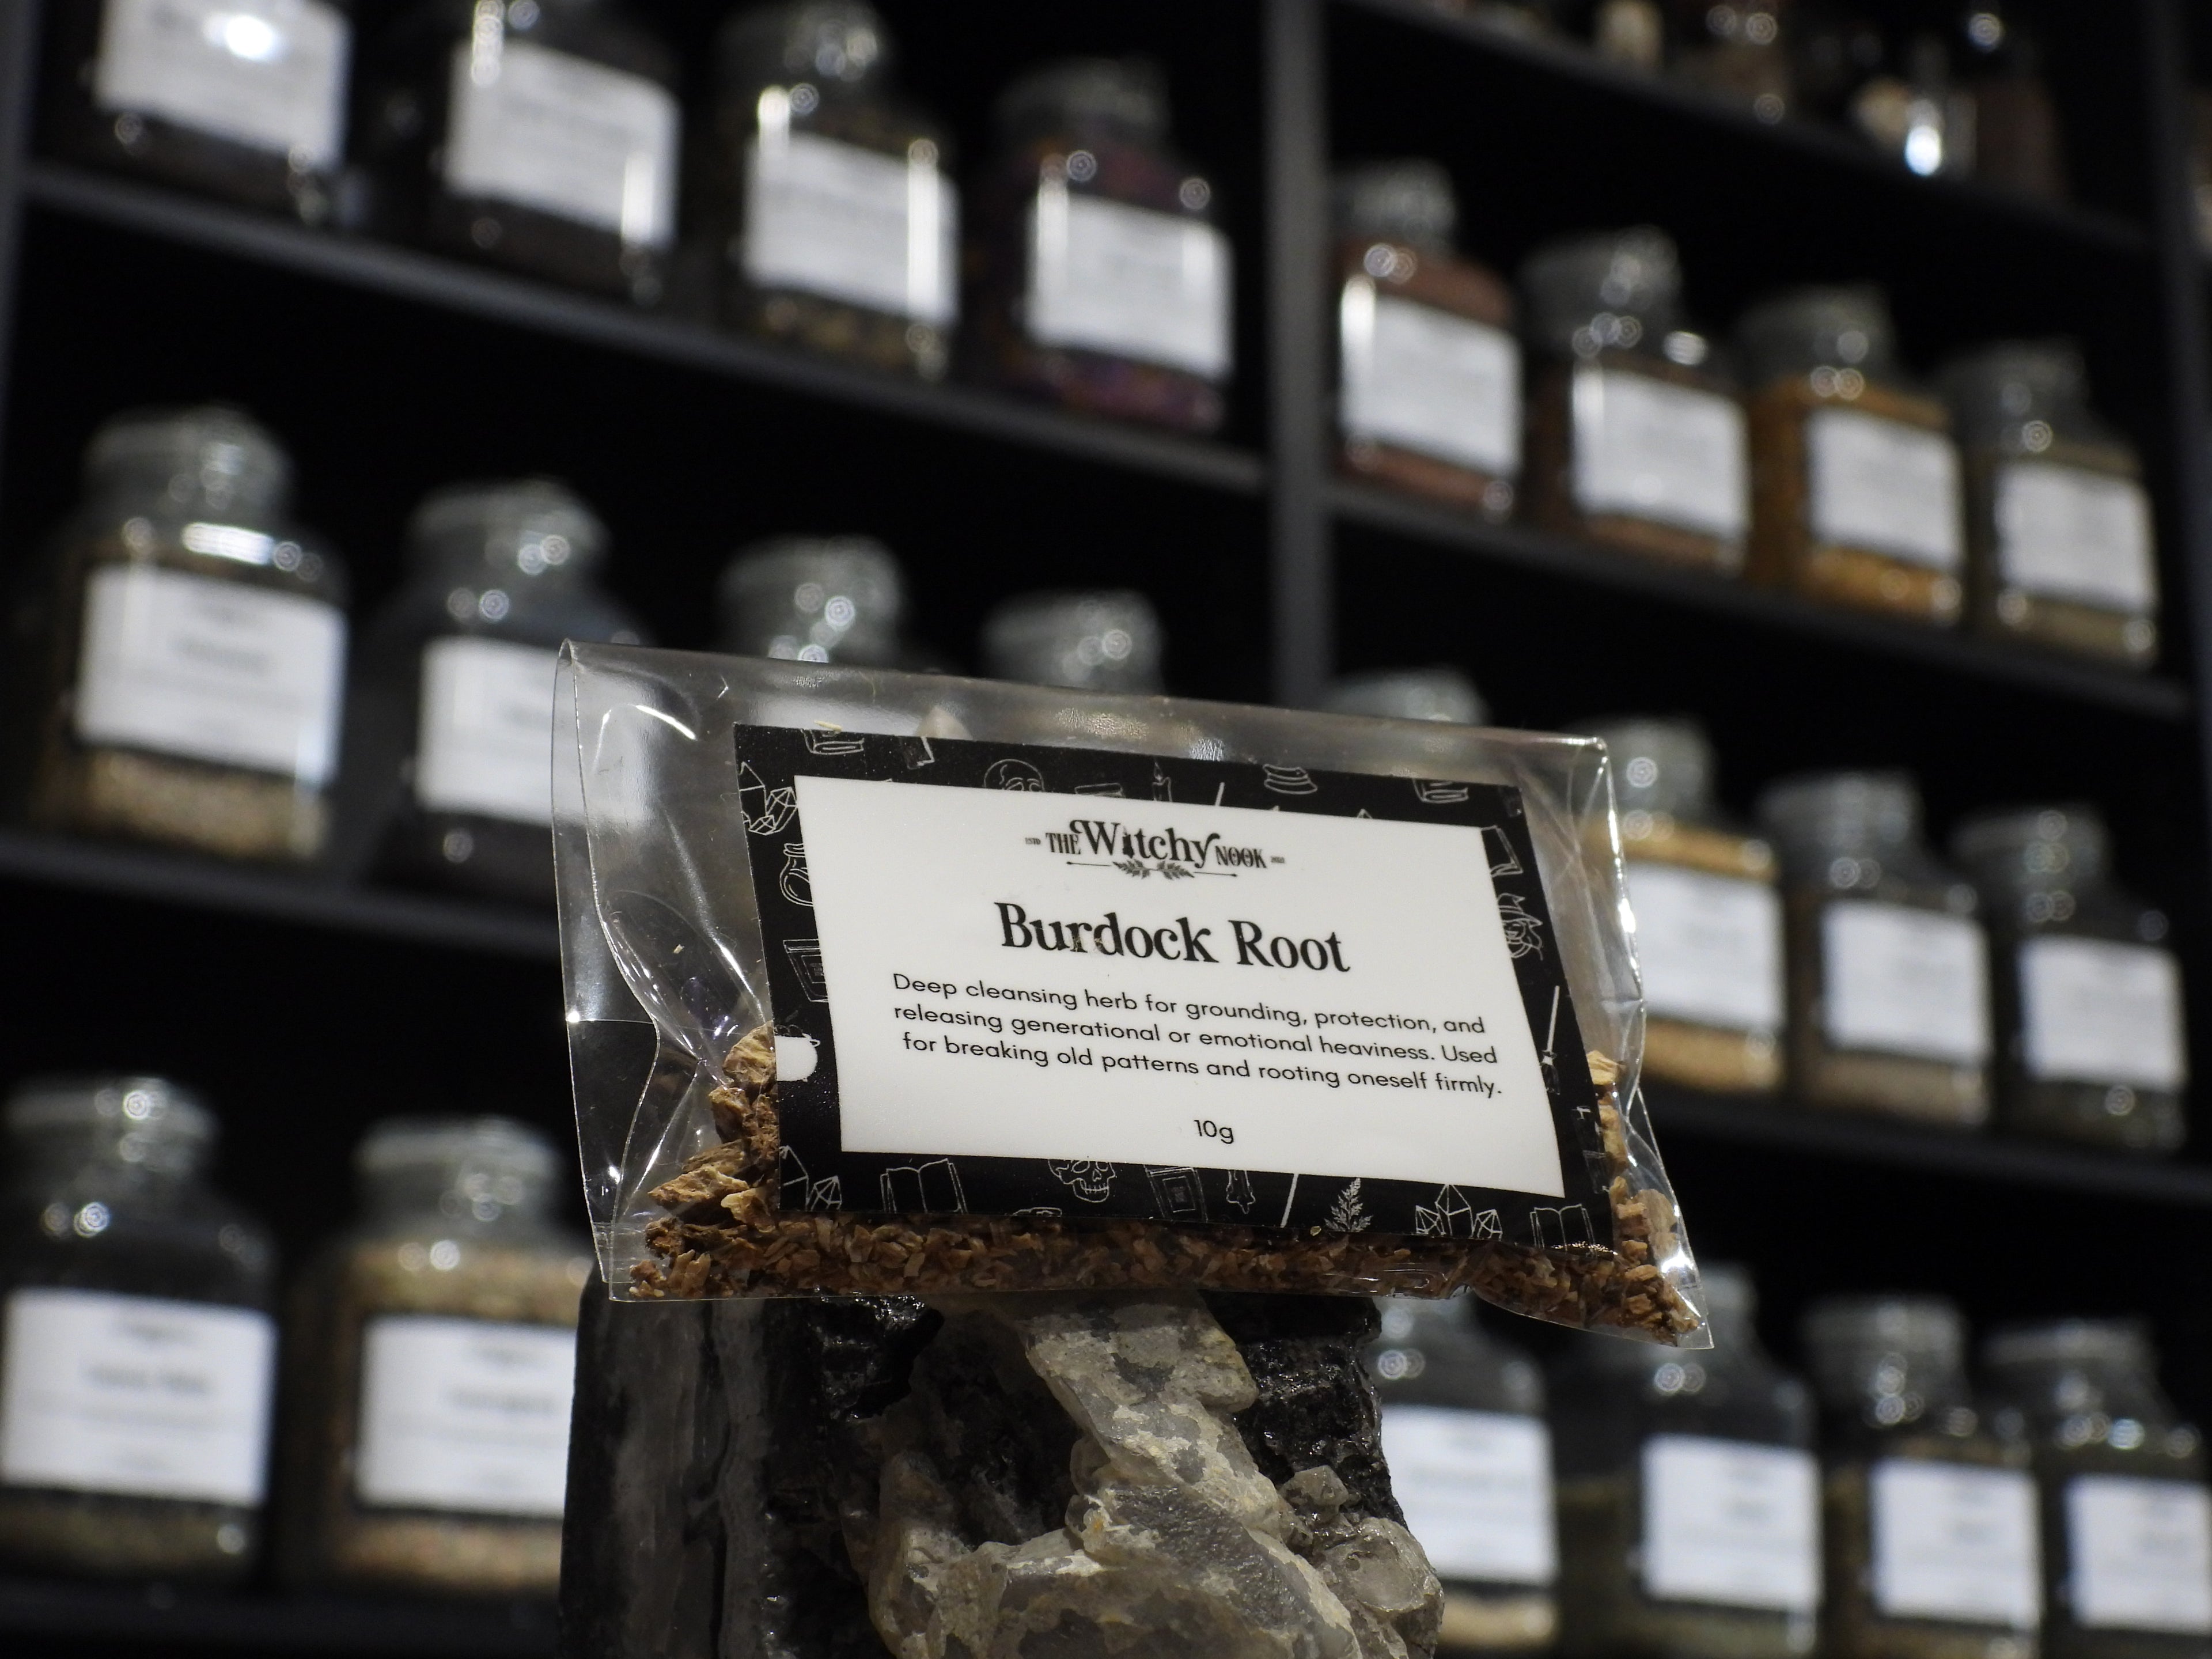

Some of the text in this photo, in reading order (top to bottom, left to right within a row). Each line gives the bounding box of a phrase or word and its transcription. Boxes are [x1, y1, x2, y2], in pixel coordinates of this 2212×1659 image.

[1045, 832, 1081, 855] THE
[1069, 819, 1221, 869] Witchy
[1214, 845, 1267, 869] NOOK
[993, 902, 1351, 972] Burdock Root
[893, 973, 1485, 1033] Deep cleansing herb for grounding, protection, and
[894, 1003, 1498, 1063] releasing generational or emotional heaviness. Used
[902, 1031, 1502, 1099] for breaking old patterns and rooting oneself firmly.
[1193, 1119, 1234, 1145] 10g
